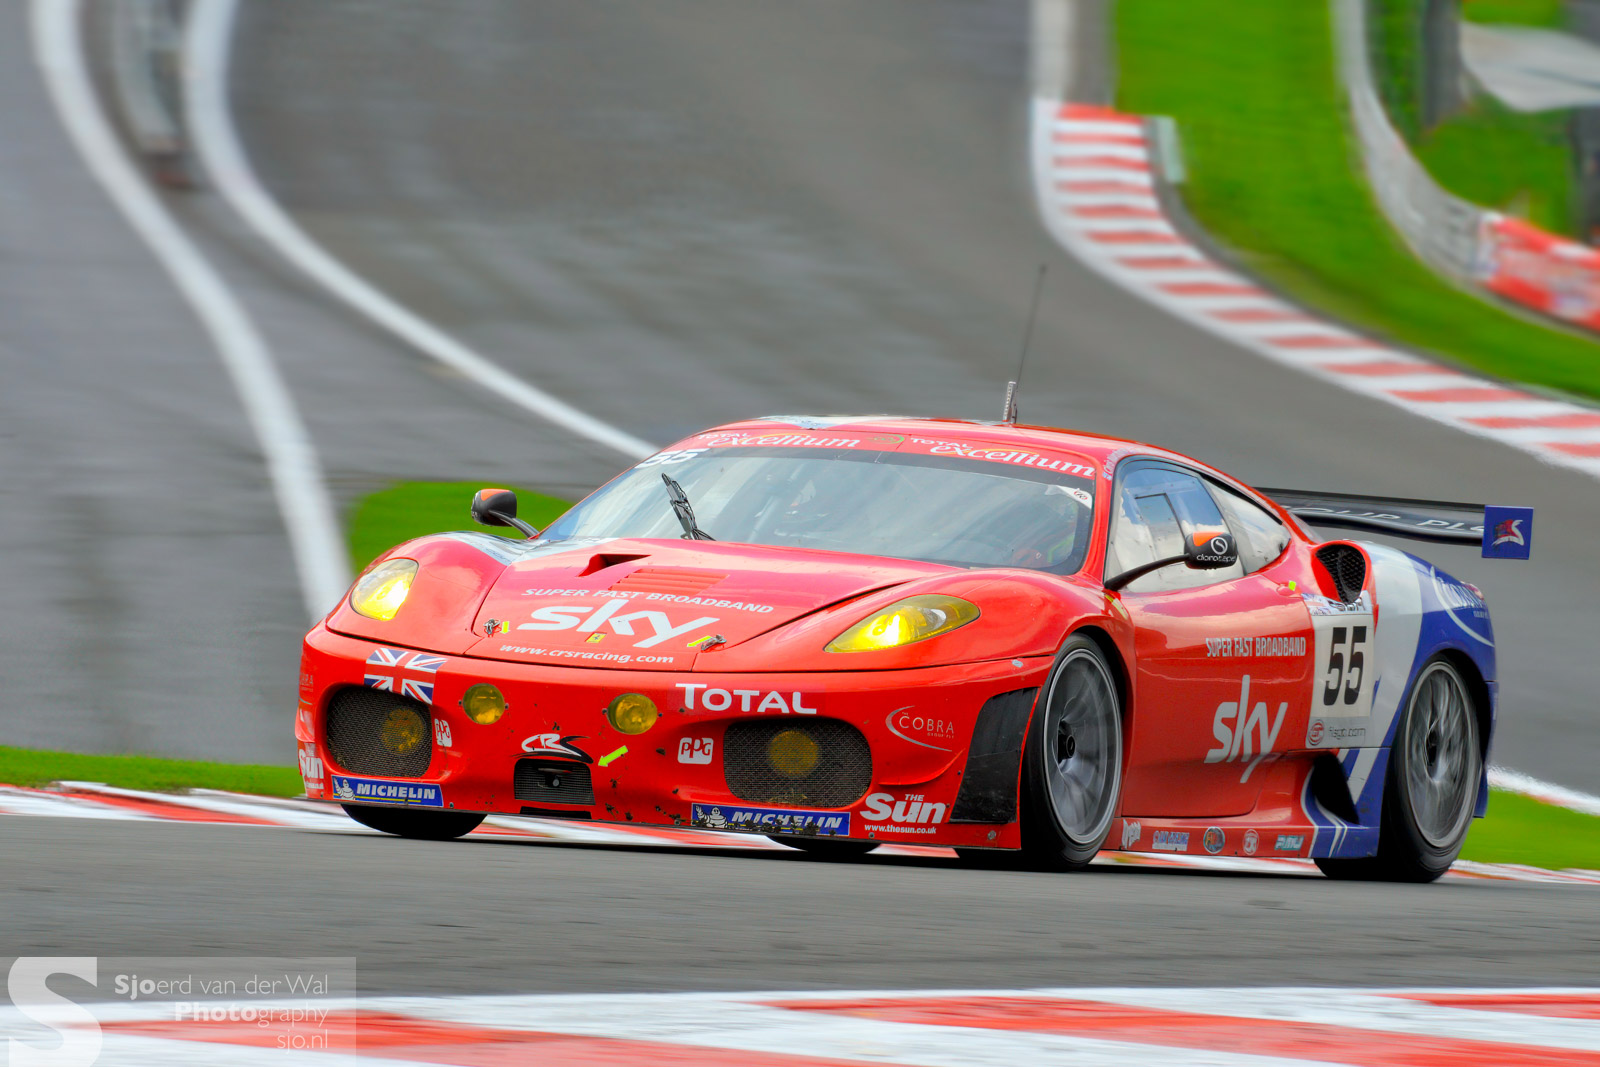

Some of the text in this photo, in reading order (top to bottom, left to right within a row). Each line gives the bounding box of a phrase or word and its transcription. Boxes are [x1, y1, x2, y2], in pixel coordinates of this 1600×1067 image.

[707, 434, 861, 448] excellium
[910, 437, 974, 449] TOTAL
[634, 447, 711, 469] 55
[930, 443, 1097, 477] excellium
[521, 588, 774, 614] SUPER FAST BROADBAND
[516, 599, 720, 648] sky
[500, 644, 674, 664] www.crsracing.com
[1205, 636, 1306, 657] SUPER FAST BROADBAND
[1323, 625, 1367, 706] 55
[675, 683, 817, 715] TOTAL
[899, 715, 954, 734] COBRA
[1204, 674, 1289, 784] sky
[356, 783, 436, 800] MICHELIN
[904, 793, 924, 801] THE
[860, 793, 946, 823] Sun
[731, 811, 843, 829] MICHELIN
[864, 824, 937, 834] www.thesun.co.uk
